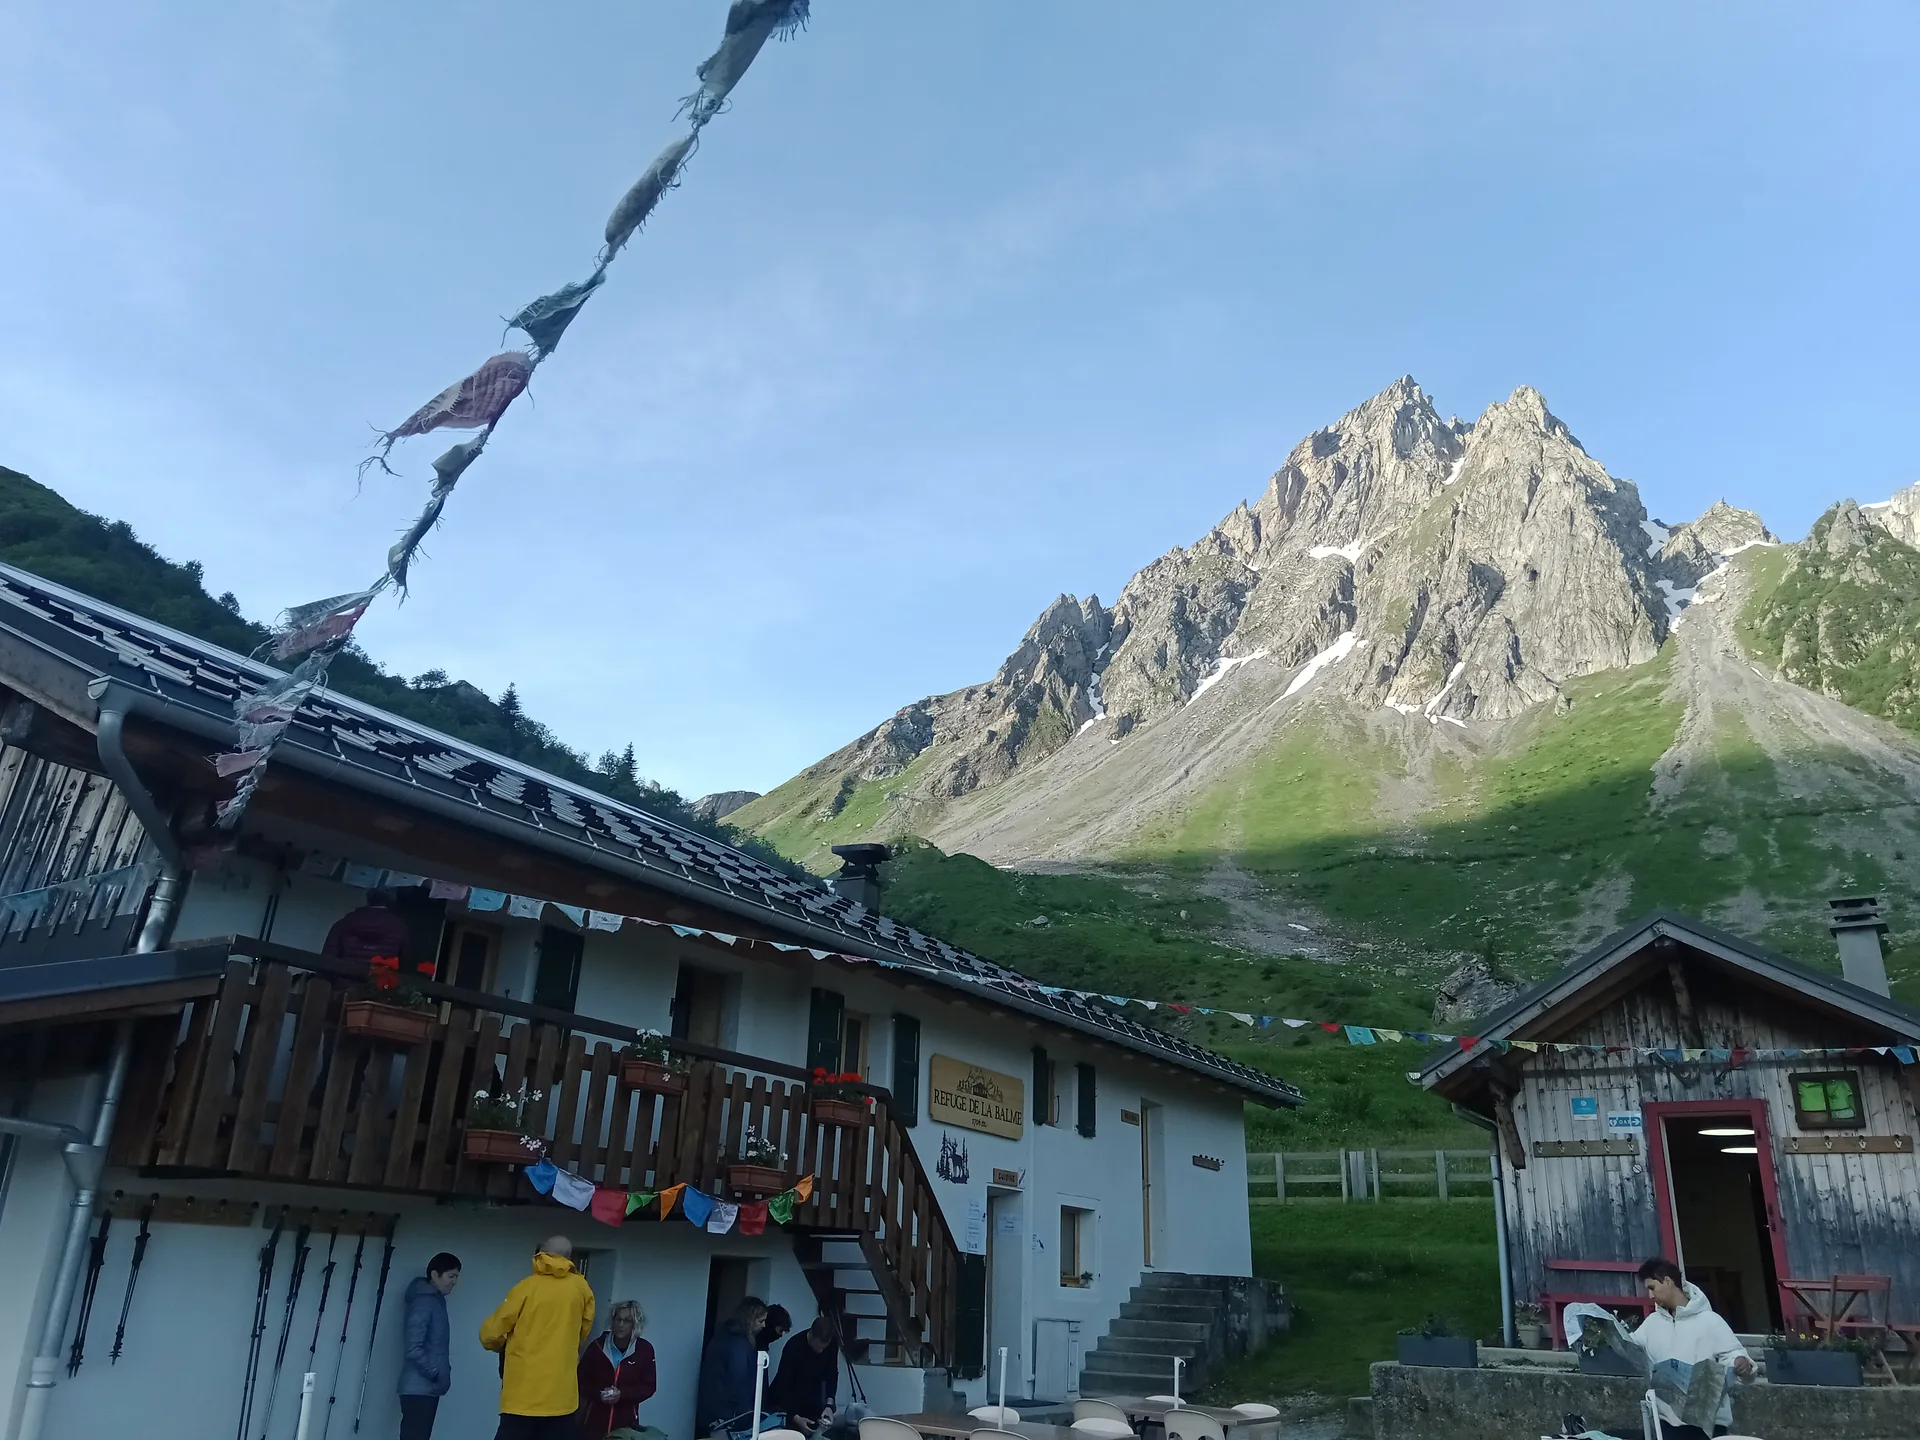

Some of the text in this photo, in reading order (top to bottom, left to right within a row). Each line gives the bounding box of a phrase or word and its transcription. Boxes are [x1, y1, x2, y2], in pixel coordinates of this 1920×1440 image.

[934, 1088, 1022, 1125] REFUGE DE LA BALME
[998, 1172, 1015, 1183] CUISINE
